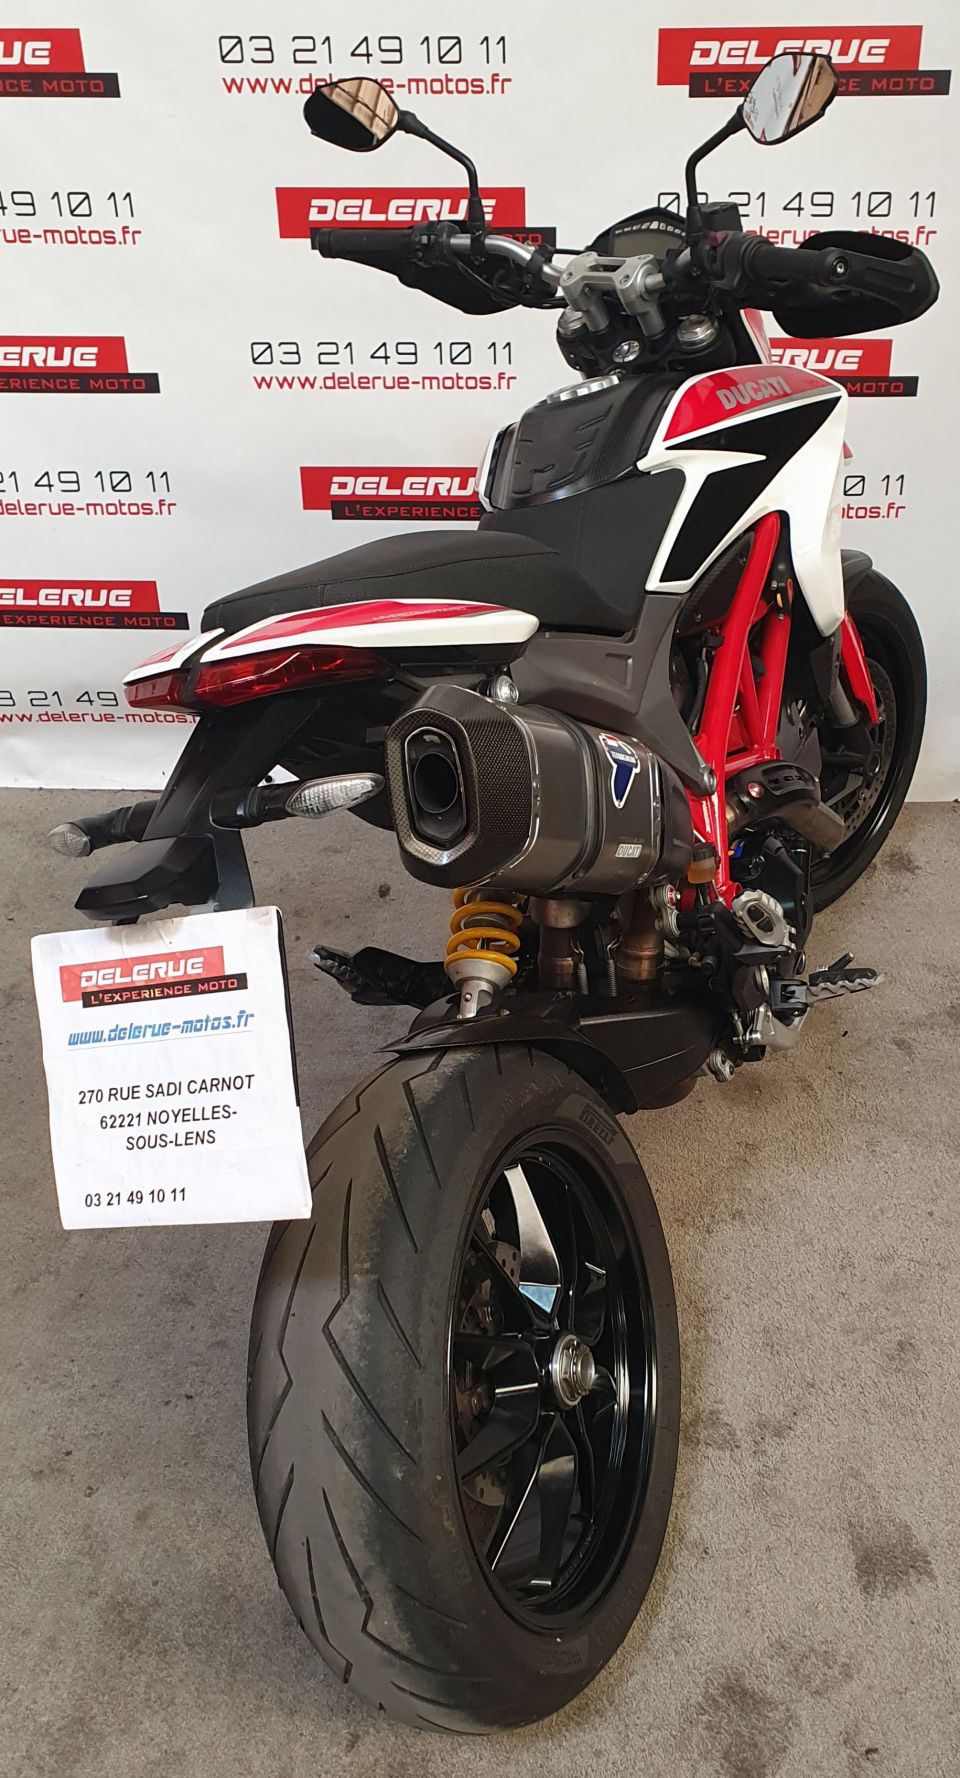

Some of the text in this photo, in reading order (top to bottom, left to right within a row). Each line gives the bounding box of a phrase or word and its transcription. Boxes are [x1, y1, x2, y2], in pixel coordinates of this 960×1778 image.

[218, 35, 507, 65] 03 21 49 10 11
[0, 80, 104, 93] CE MOTO
[222, 73, 512, 95] www.dele-motos.fr
[871, 77, 934, 91] MOTO
[51, 191, 92, 217] 10
[107, 192, 135, 218] 11
[308, 198, 497, 222] DELERUE
[728, 191, 766, 217] 21
[783, 191, 835, 217] 49
[851, 191, 892, 217] 10
[909, 191, 936, 217] 11
[0, 225, 142, 245] ue-motos.fr
[0, 346, 98, 367] ERUE
[250, 341, 512, 366] 03 21 49 10 11
[90, 379, 145, 390] MOTO
[253, 371, 518, 391] www.delerue-motos.fr
[847, 382, 904, 394] MOTO
[716, 375, 793, 411] DUCATI
[0, 471, 171, 493] 1 49 10 11
[881, 474, 905, 496] 11
[344, 504, 481, 518] L'EXPERIENCE
[842, 502, 907, 520] tos.fr
[3, 614, 176, 627] EXPERIENCE MOTO
[27, 690, 62, 707] 21
[76, 690, 119, 708] 49
[617, 845, 642, 858] DUCAT
[80, 956, 204, 988] DELERUE
[91, 978, 238, 1005] L'EXPERIENCE MOTO
[68, 1009, 255, 1046] www.delerue-motos.fr
[78, 1074, 255, 1105] 270 RUE SADI CARNOT
[100, 1104, 238, 1130] 62221 NOYELLES-
[126, 1129, 216, 1151] SOUS-LENS
[85, 1187, 187, 1208] 03 21 49 10 11
